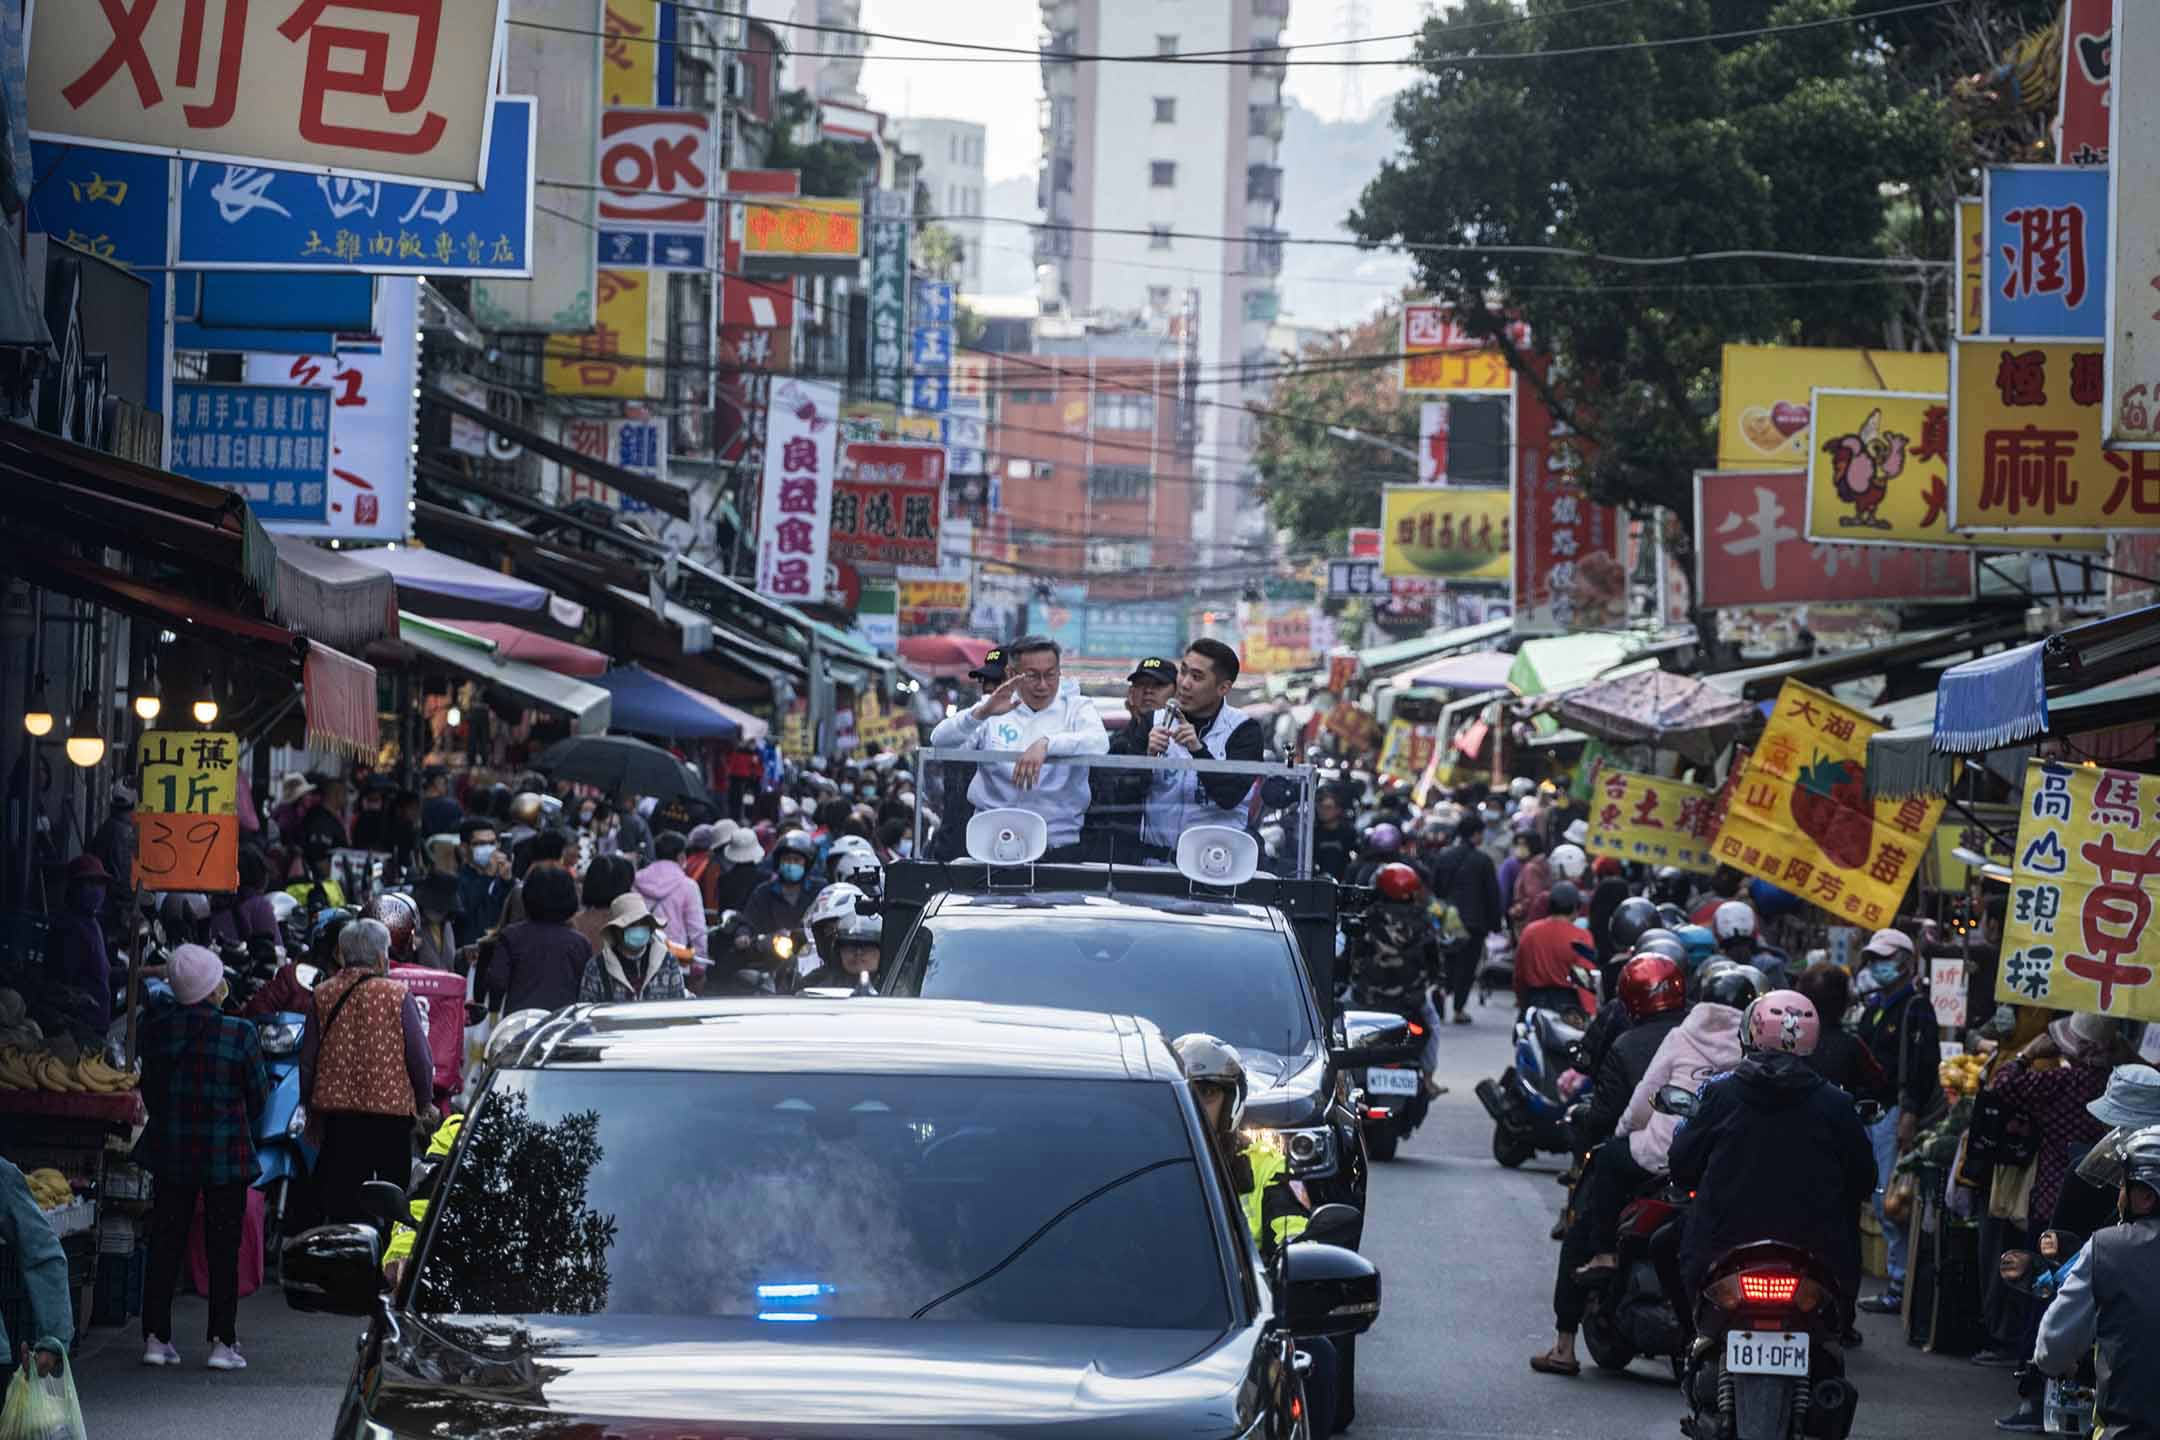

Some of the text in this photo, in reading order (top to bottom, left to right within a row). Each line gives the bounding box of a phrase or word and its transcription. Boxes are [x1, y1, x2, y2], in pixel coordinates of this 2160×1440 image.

[601, 136, 705, 198] OK
[300, 230, 516, 264] 土雞肉飯專賣店
[2003, 202, 2087, 309] 潤
[772, 437, 818, 595] 良益食品
[1787, 698, 1856, 743] 大湖
[143, 737, 233, 770] 山蕉
[141, 821, 220, 877] 39
[1732, 1344, 1807, 1369] 181-DFM
